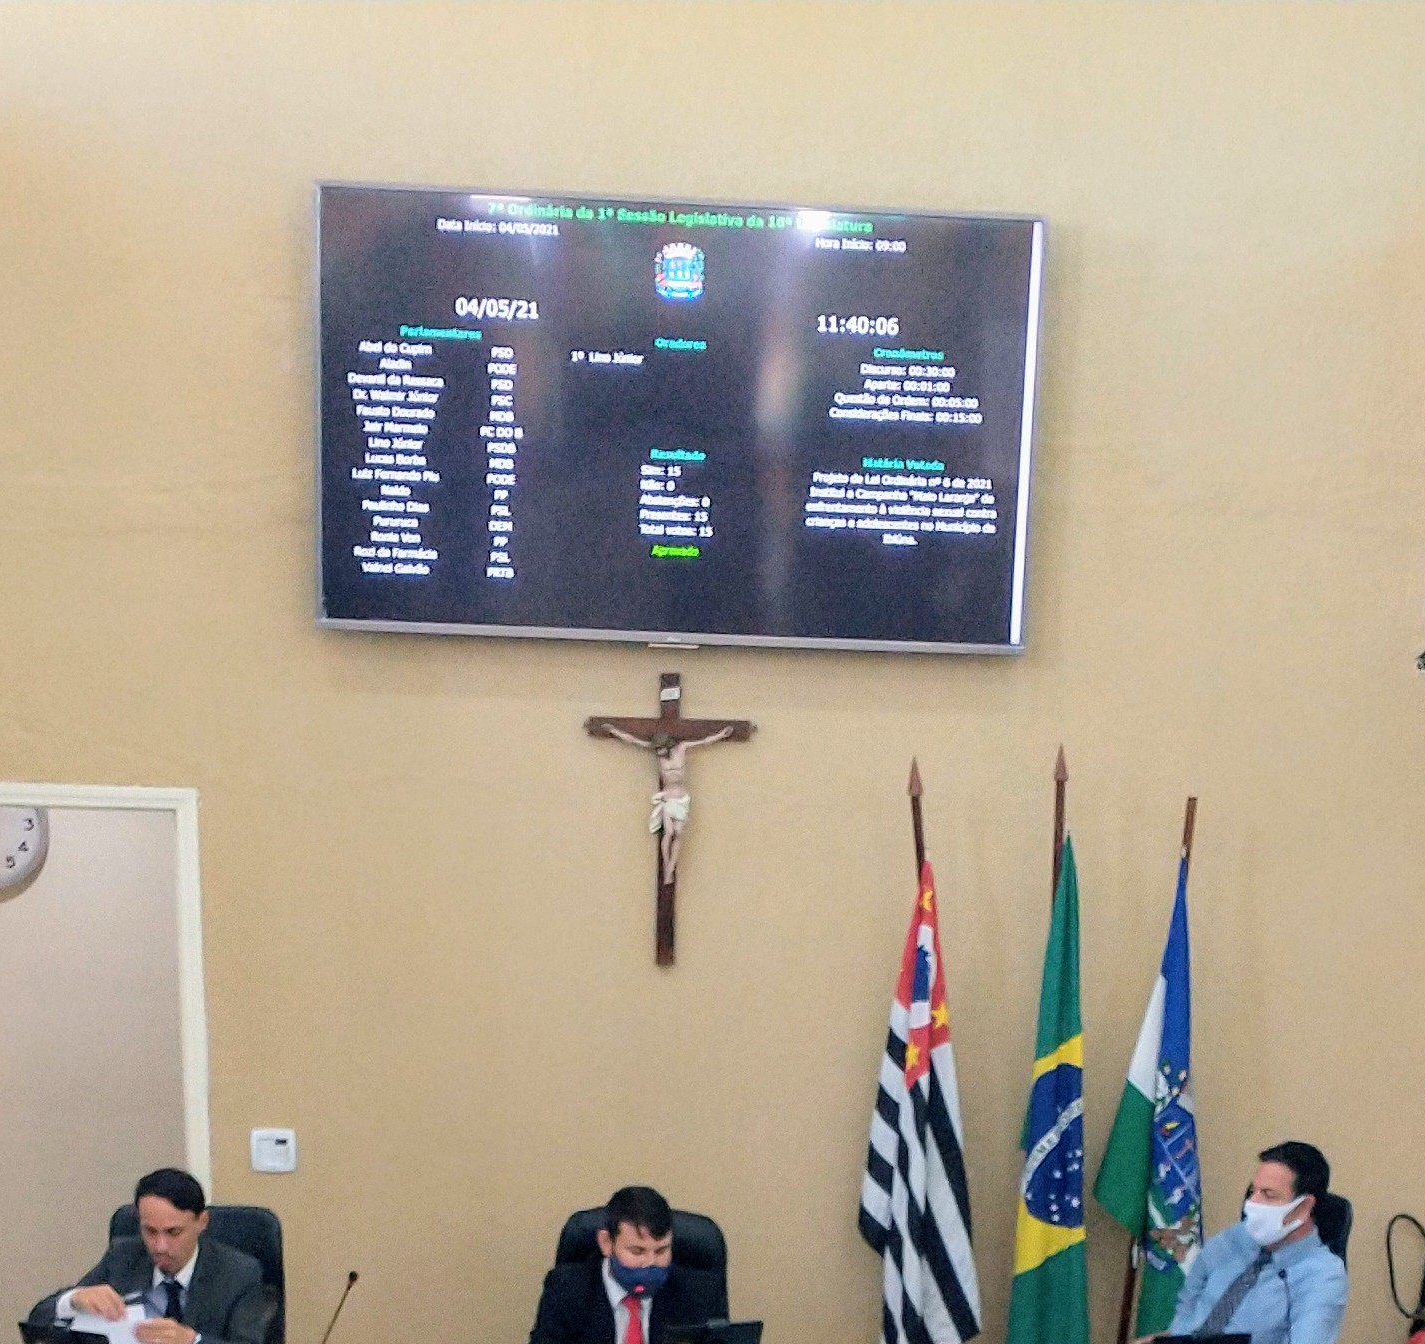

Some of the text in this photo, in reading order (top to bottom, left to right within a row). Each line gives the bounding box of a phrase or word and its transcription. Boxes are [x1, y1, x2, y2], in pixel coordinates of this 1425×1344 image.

[575, 205, 594, 220] da
[668, 210, 743, 228] Legislativa
[746, 214, 764, 229] da
[874, 240, 907, 253] 09:00
[455, 297, 539, 320] 04/05/21
[816, 315, 899, 335] 11:40:06
[908, 366, 955, 378] 00:30:00
[902, 381, 950, 393] 00:01:00
[931, 397, 978, 409] 00:05:00
[935, 412, 982, 424] 00:15:00
[667, 466, 681, 476] 15
[966, 478, 992, 489] 2021
[693, 512, 708, 522] 15
[698, 527, 713, 537] 15
[23, 818, 35, 832] 3
[17, 841, 30, 852] 4
